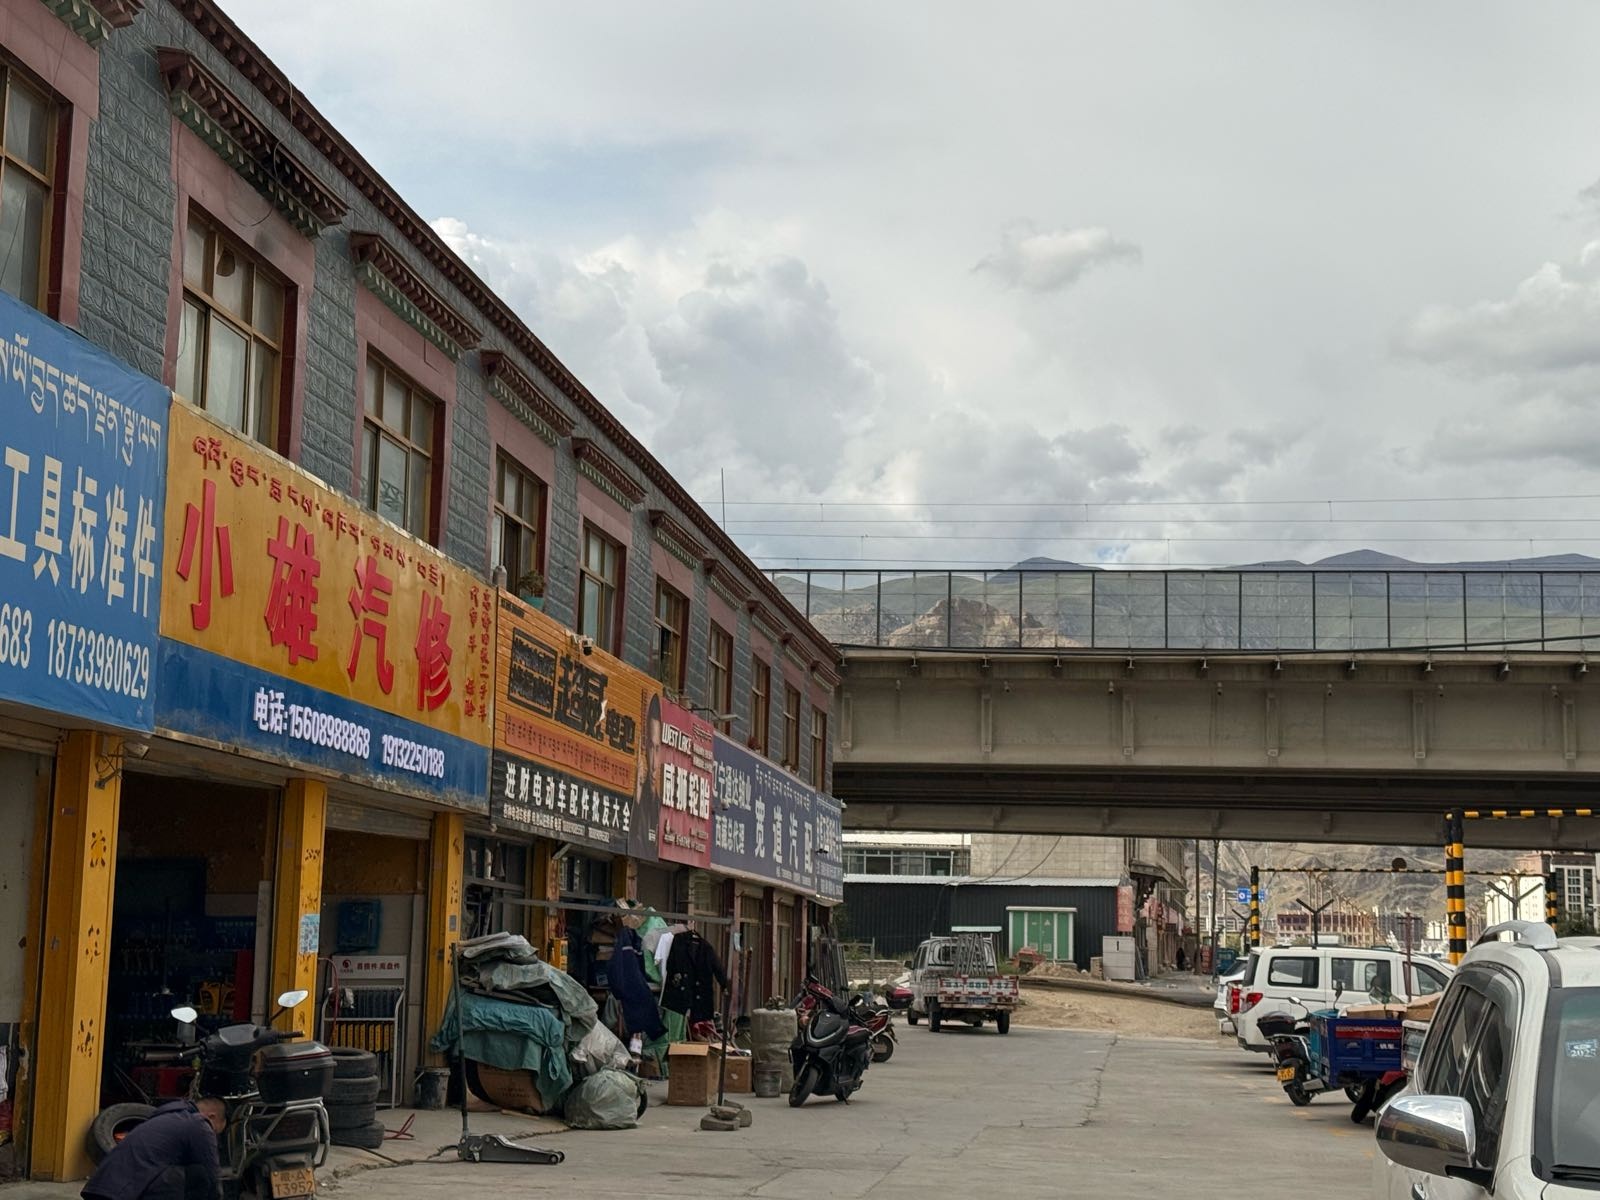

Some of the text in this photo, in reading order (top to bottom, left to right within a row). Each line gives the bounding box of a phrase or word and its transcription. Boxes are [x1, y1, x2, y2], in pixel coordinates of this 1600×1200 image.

[0, 446, 155, 617] 工具标准件
[176, 478, 453, 712] 小雄汽修
[47, 618, 149, 699] 18733980629
[253, 687, 445, 778] 电话: 15608988868 19132250188
[661, 722, 678, 749] WEST
[505, 762, 630, 832] 进财电动车配件批发大全
[275, 1180, 315, 1197] T3952
